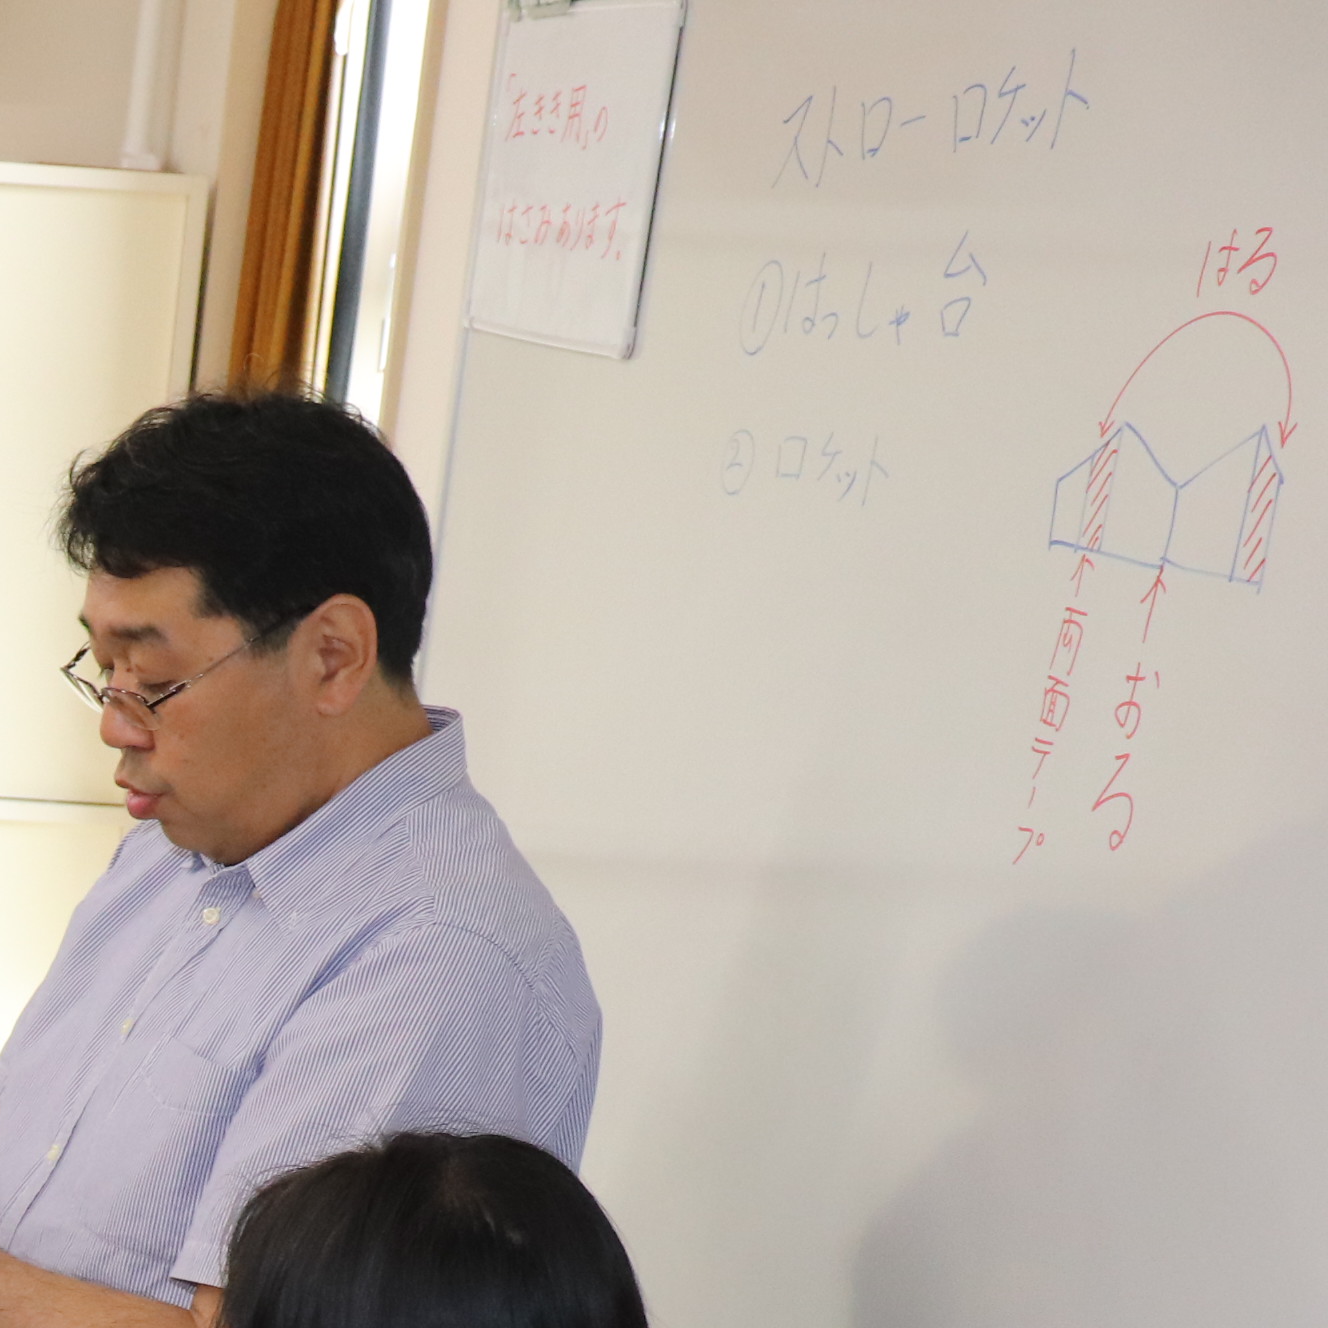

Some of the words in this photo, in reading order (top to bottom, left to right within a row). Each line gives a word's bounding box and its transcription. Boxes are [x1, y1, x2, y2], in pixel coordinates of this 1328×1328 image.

[1196, 225, 1279, 298] はる
[1012, 606, 1088, 866] 両面テープ
[1091, 661, 1160, 851] おる
